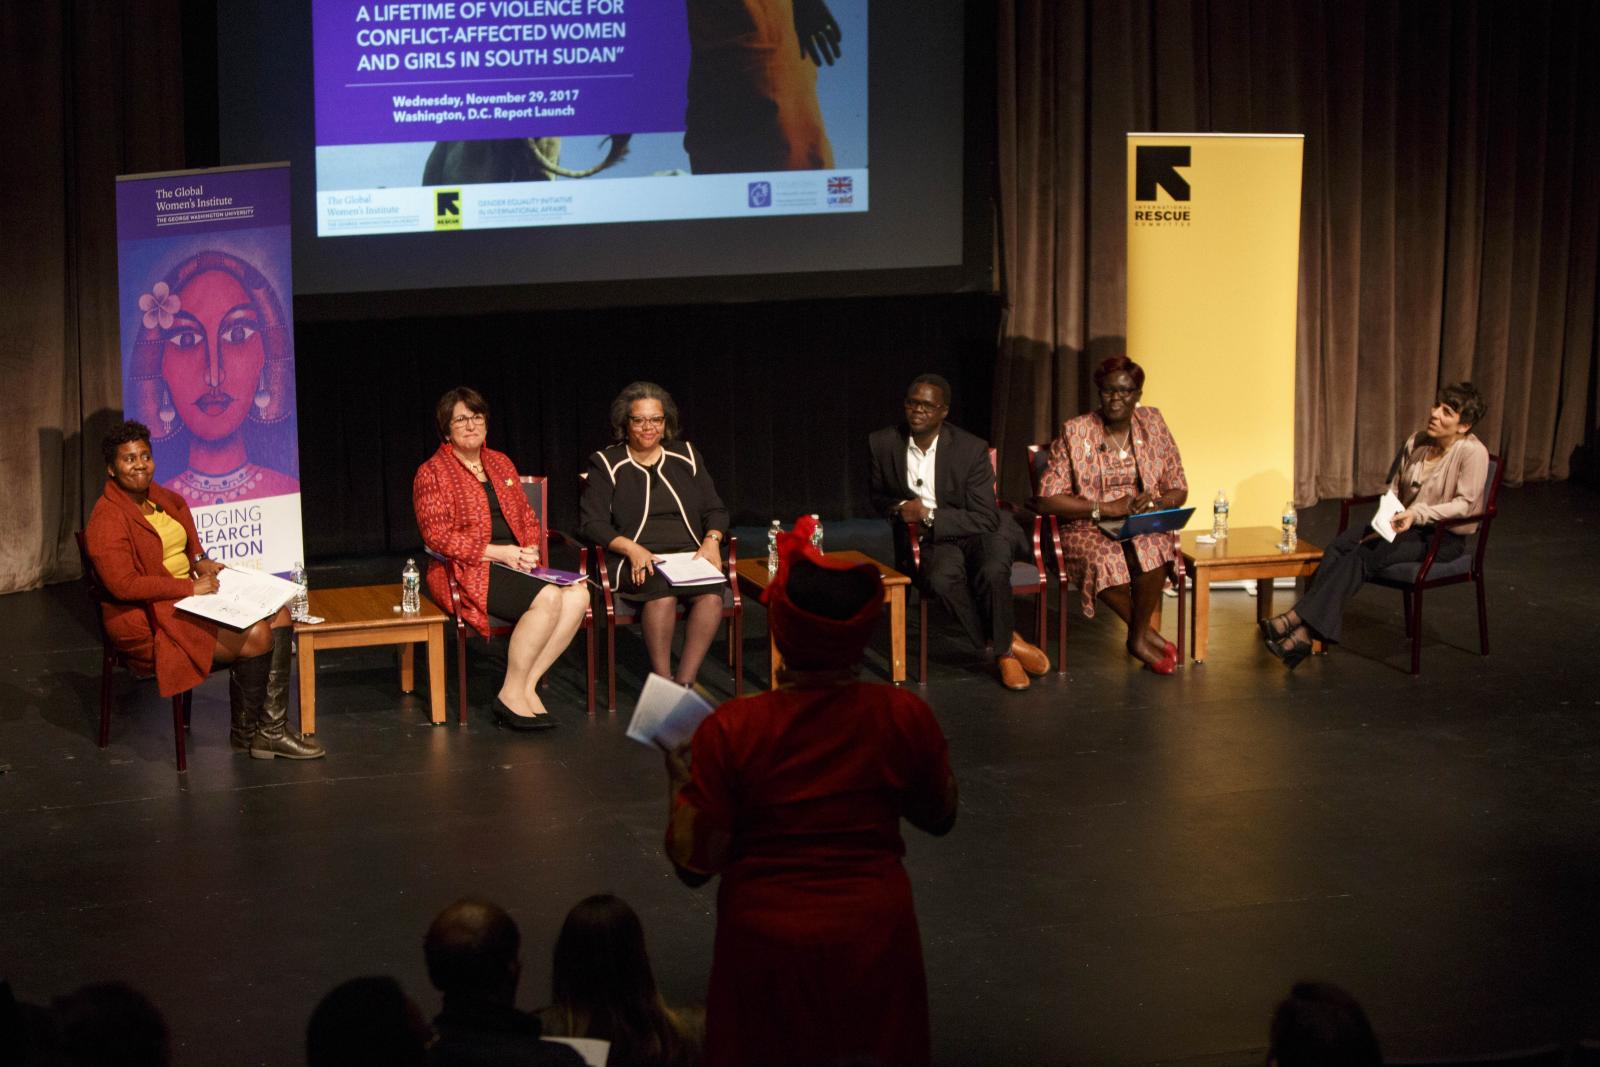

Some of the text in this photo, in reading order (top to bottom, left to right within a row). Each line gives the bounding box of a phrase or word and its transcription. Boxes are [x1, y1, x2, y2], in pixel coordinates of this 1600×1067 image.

[356, 0, 624, 22] A LIFETIME OF VIOLENCE FOR
[356, 22, 626, 47] CONFLICT-AFFECTED WOMEN
[357, 53, 400, 71] AND
[404, 51, 456, 70] GIRLS
[461, 50, 480, 68] IN
[484, 48, 548, 67] SOUTH
[393, 89, 579, 108] Wednesday, November 29, 2017
[393, 105, 575, 124] Washington, D.C. Report Launch
[156, 185, 203, 199] The Global
[156, 196, 233, 211] Women's Institute
[168, 214, 190, 223] GEORGE
[190, 211, 224, 221] WASHINGTON
[225, 208, 254, 217] UNIVERSITY
[1135, 211, 1191, 221] RESCUE
[196, 505, 262, 529] IDGING
[198, 523, 262, 545] SEARCH
[204, 539, 263, 561] CTION
